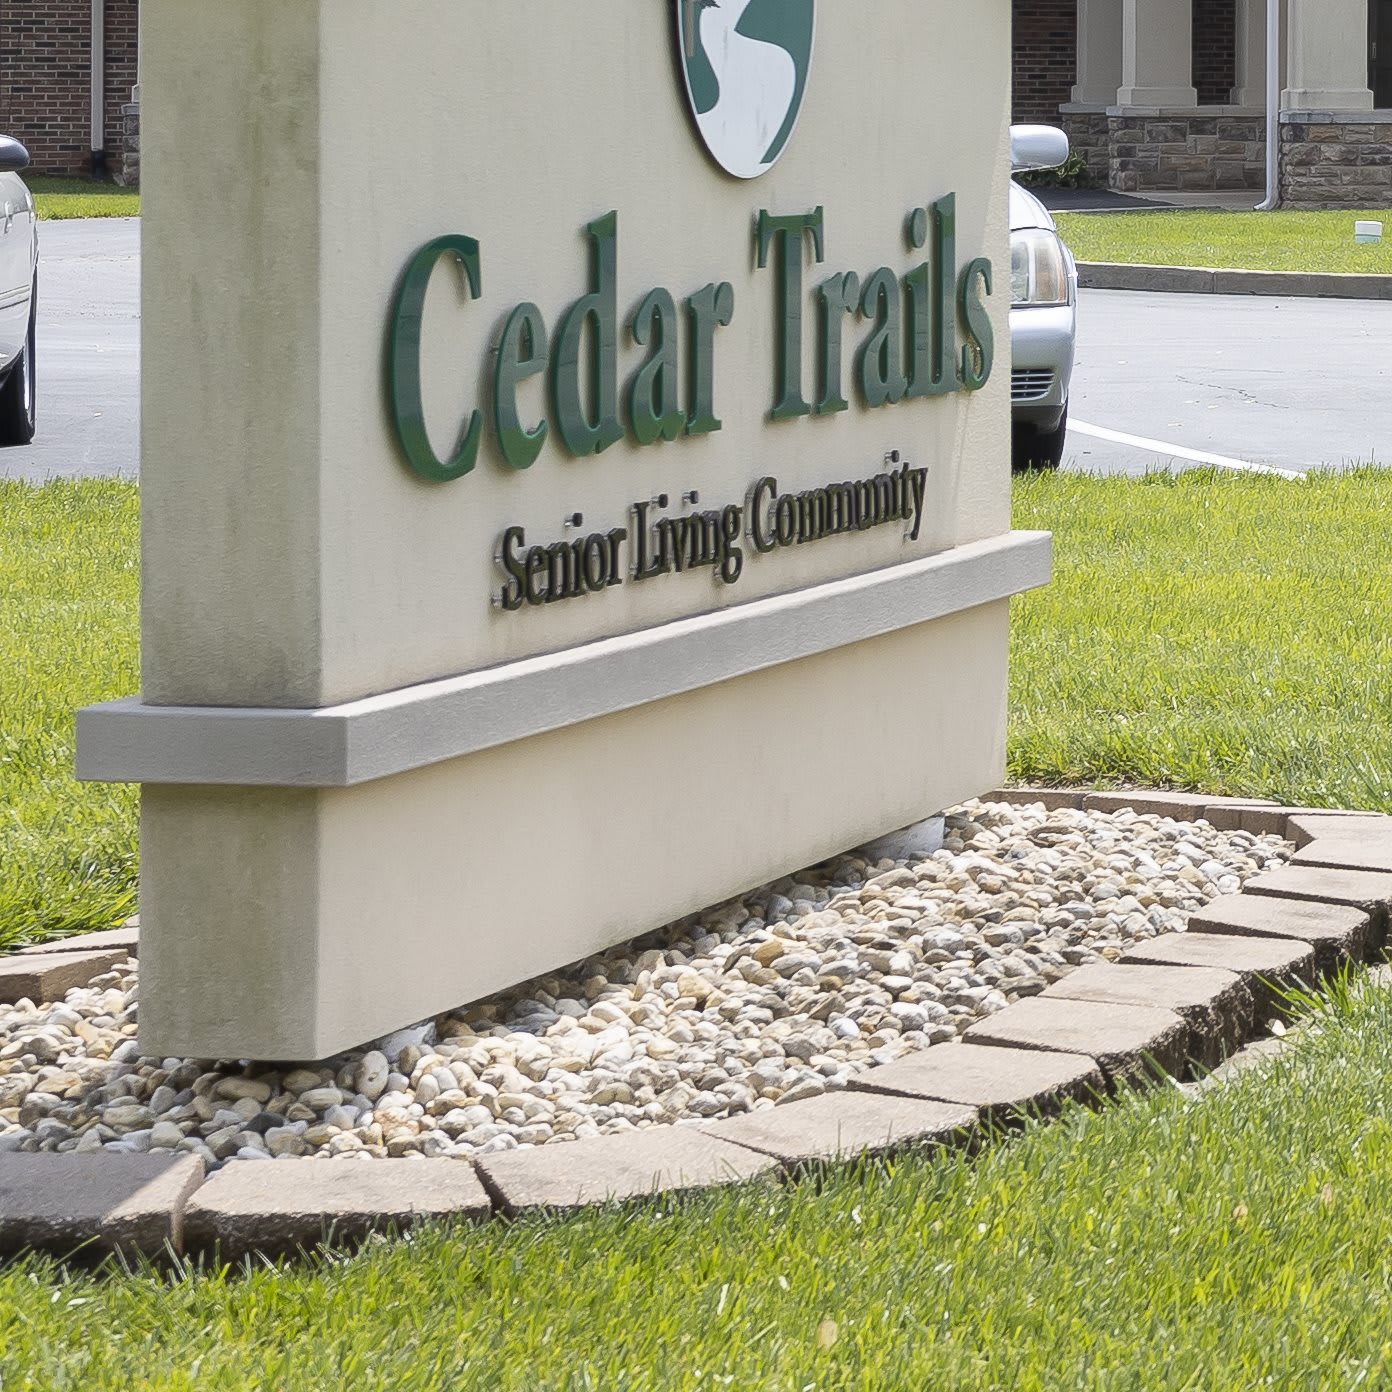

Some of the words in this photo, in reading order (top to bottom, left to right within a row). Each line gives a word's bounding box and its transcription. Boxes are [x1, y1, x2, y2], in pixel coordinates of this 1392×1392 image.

[390, 209, 734, 482] Cedar
[753, 192, 993, 421] Trails
[497, 512, 627, 610] Senior
[632, 490, 744, 584] Living
[747, 449, 929, 554] Community
